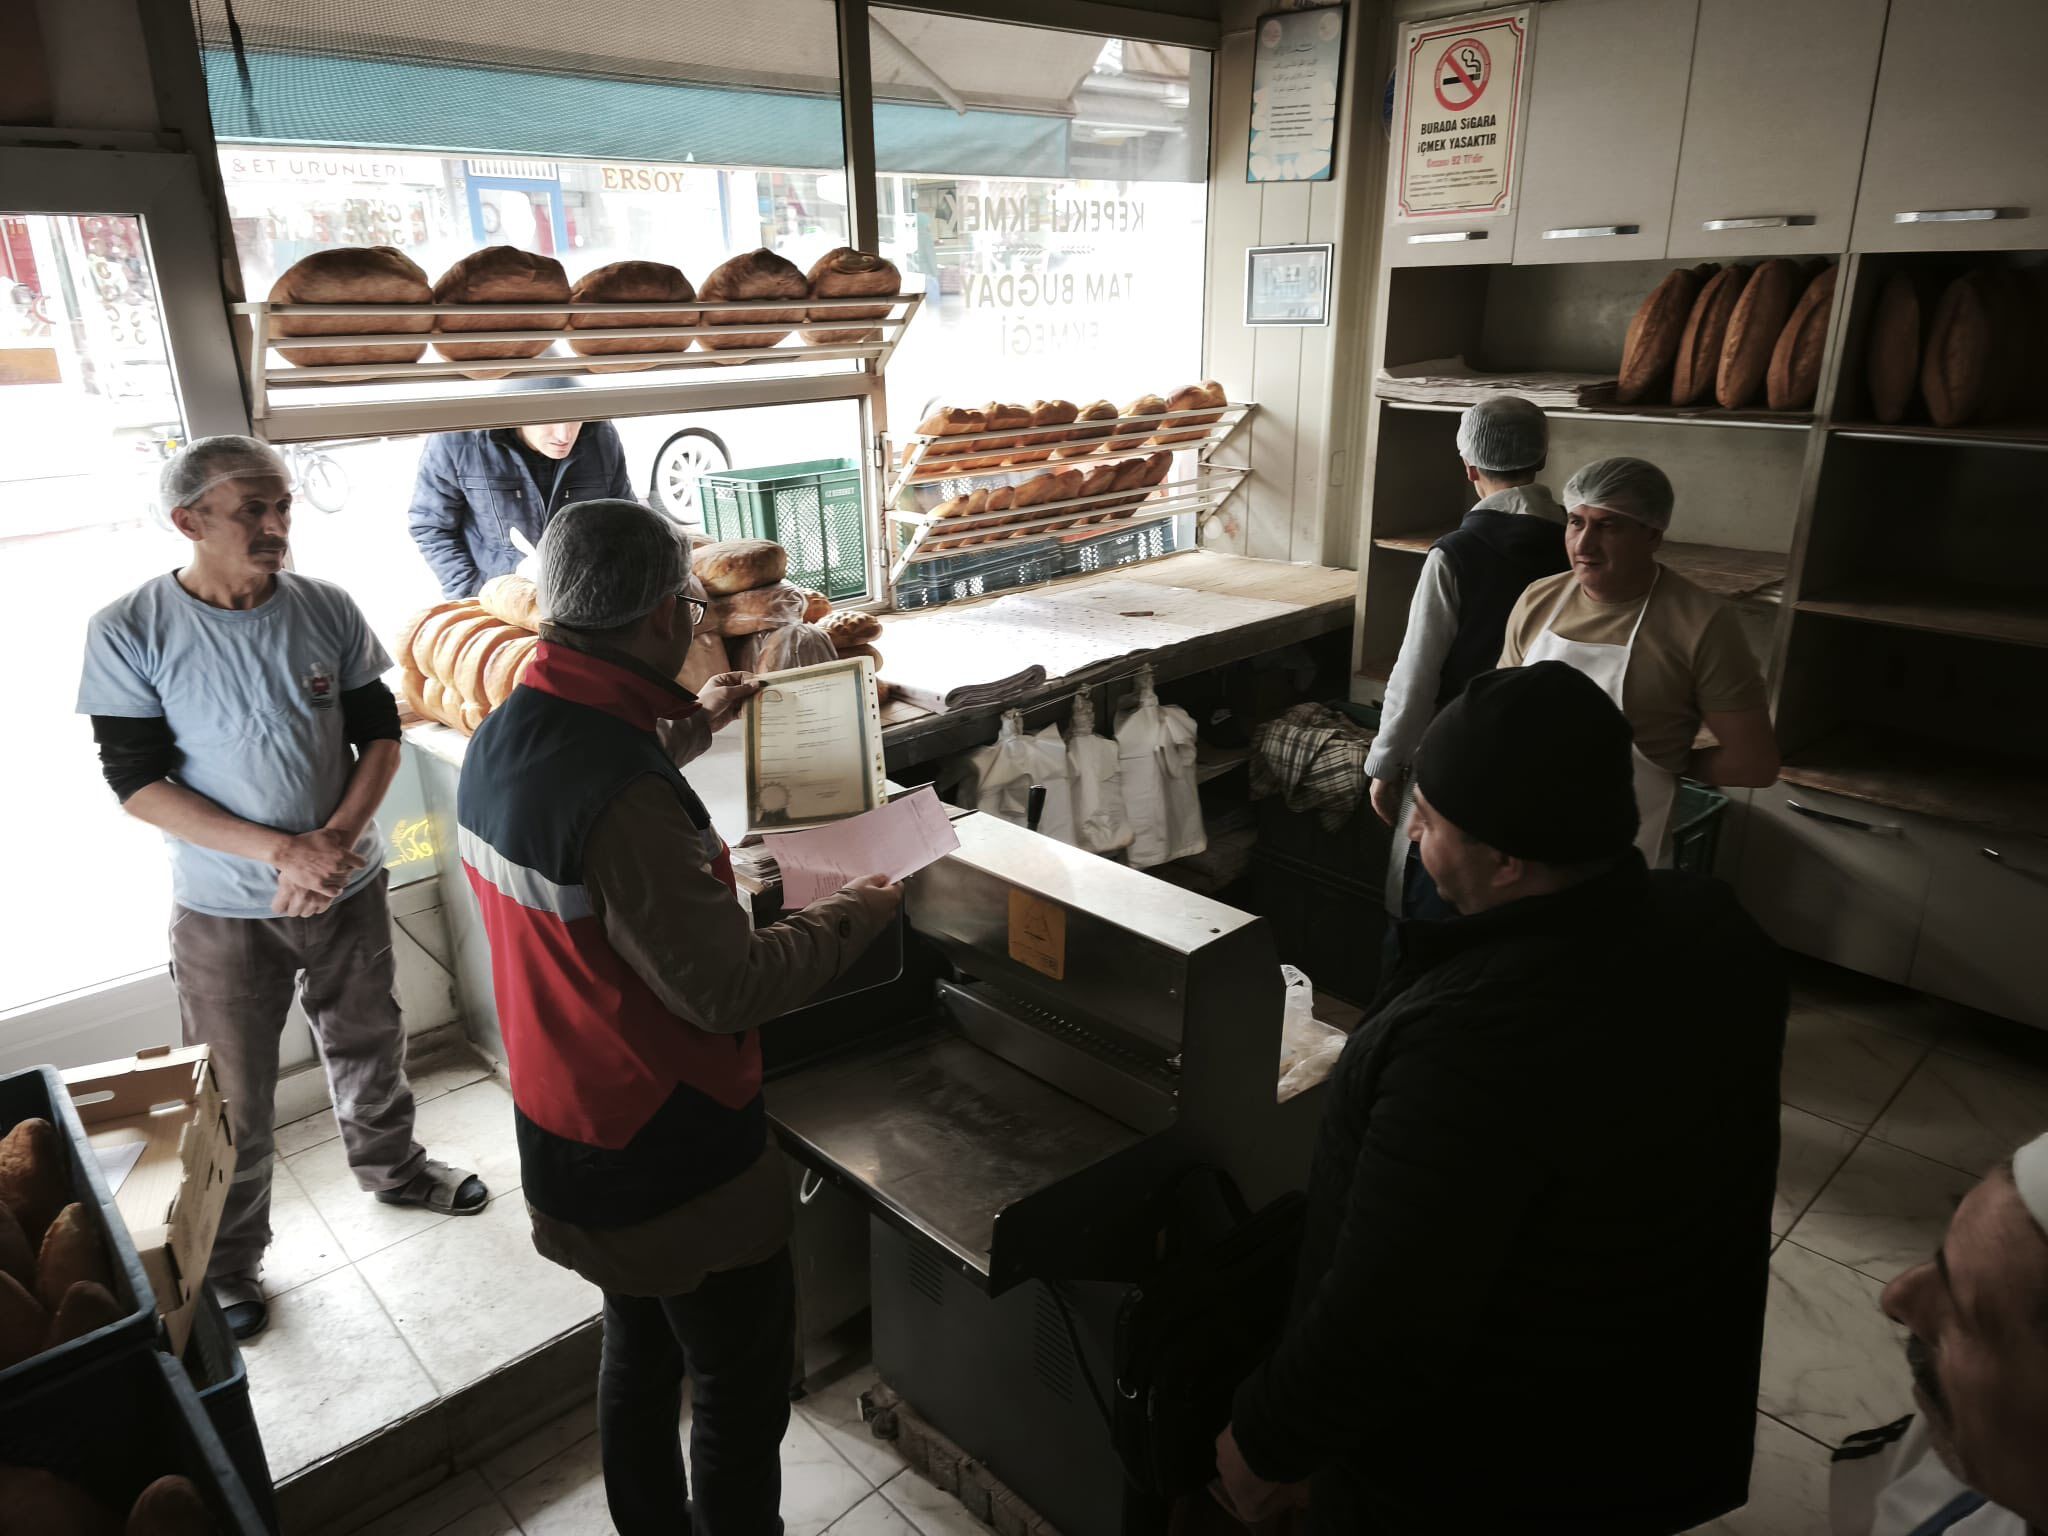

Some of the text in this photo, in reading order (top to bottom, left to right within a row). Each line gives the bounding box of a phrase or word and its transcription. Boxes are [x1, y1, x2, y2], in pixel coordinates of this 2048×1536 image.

[1421, 120, 1457, 135] BURADA
[1450, 133, 1496, 150] YASAKTIR
[252, 159, 276, 173] ET
[601, 167, 685, 192] ERSOY
